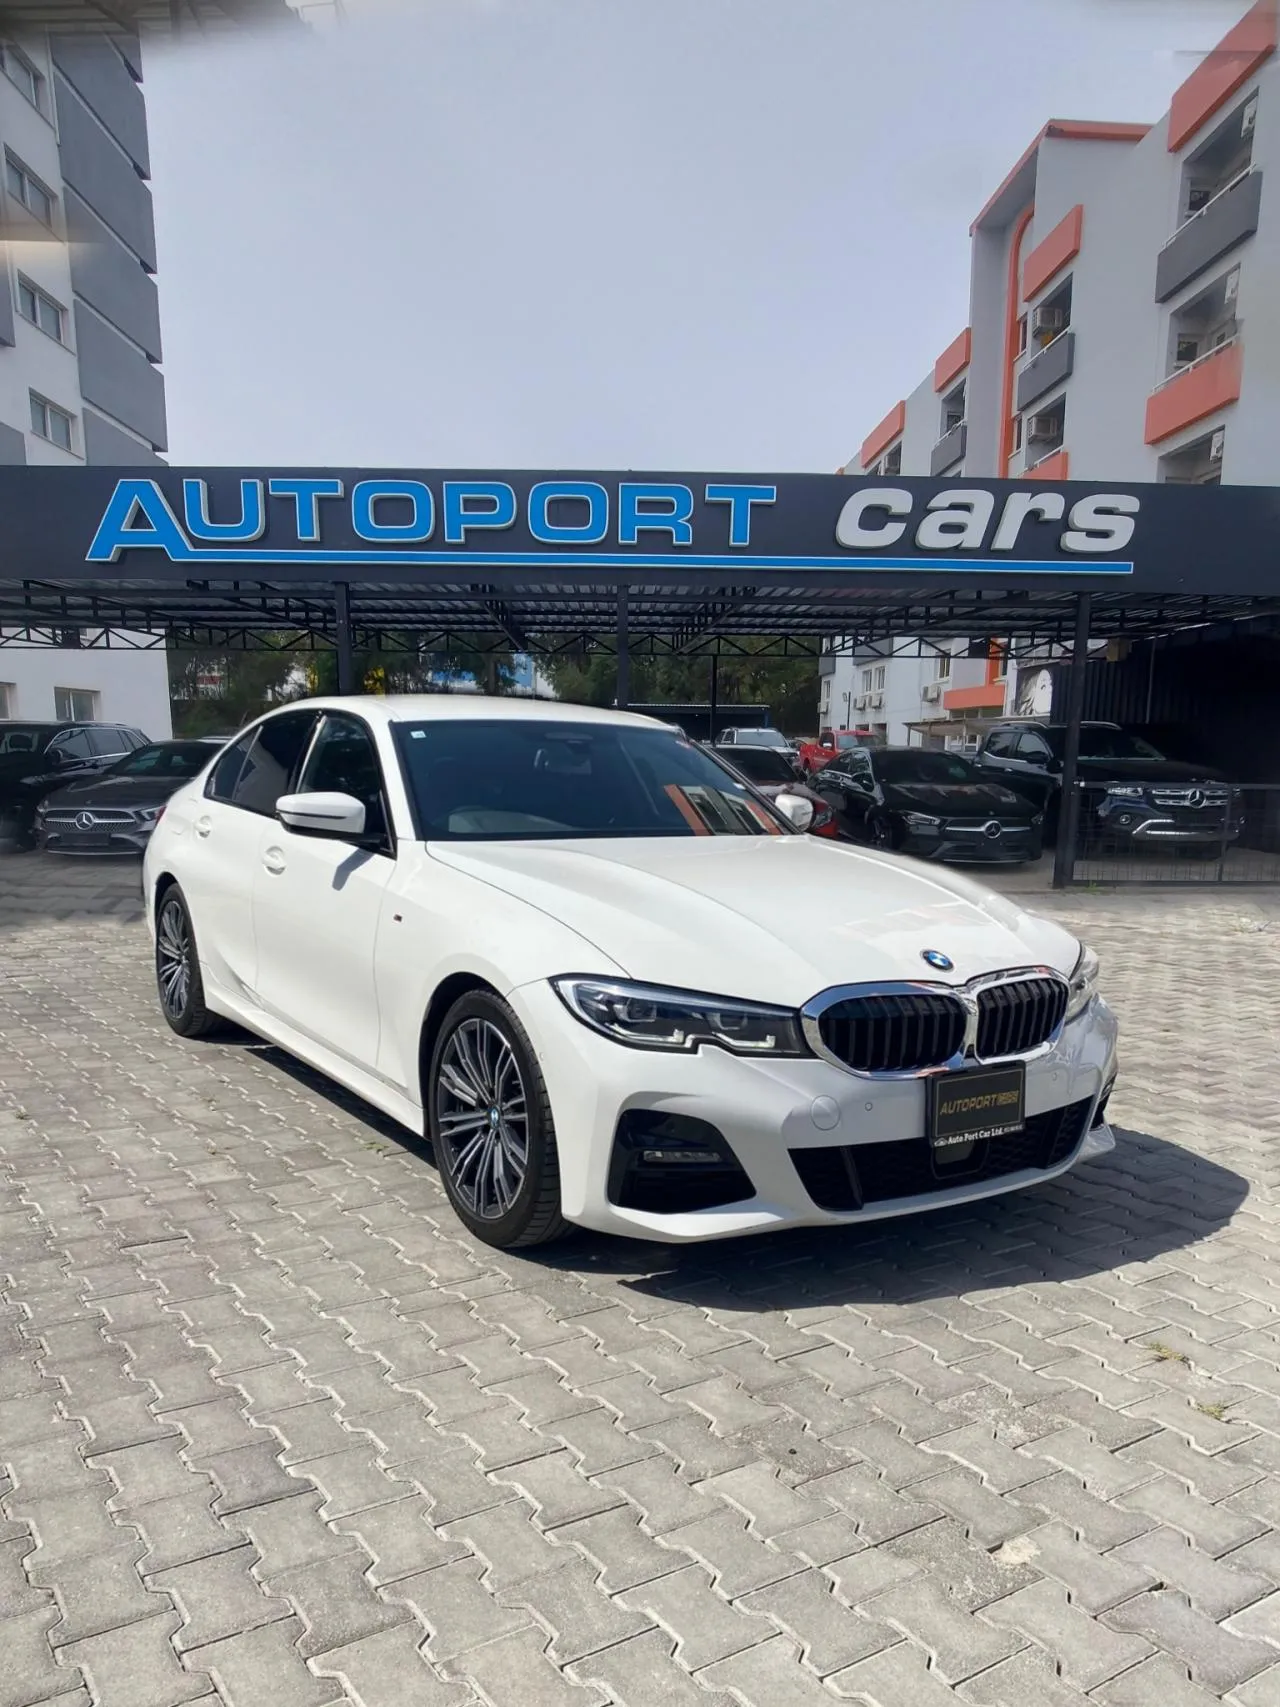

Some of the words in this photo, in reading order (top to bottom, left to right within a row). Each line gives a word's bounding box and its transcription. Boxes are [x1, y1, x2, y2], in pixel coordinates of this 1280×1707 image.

[85, 478, 777, 562] AUTOPORT
[835, 487, 1141, 552] cars
[940, 1094, 998, 1115] AUTOPORT
[947, 1136, 964, 1145] Auto
[964, 1132, 978, 1142] Port
[979, 1130, 991, 1139] Car
